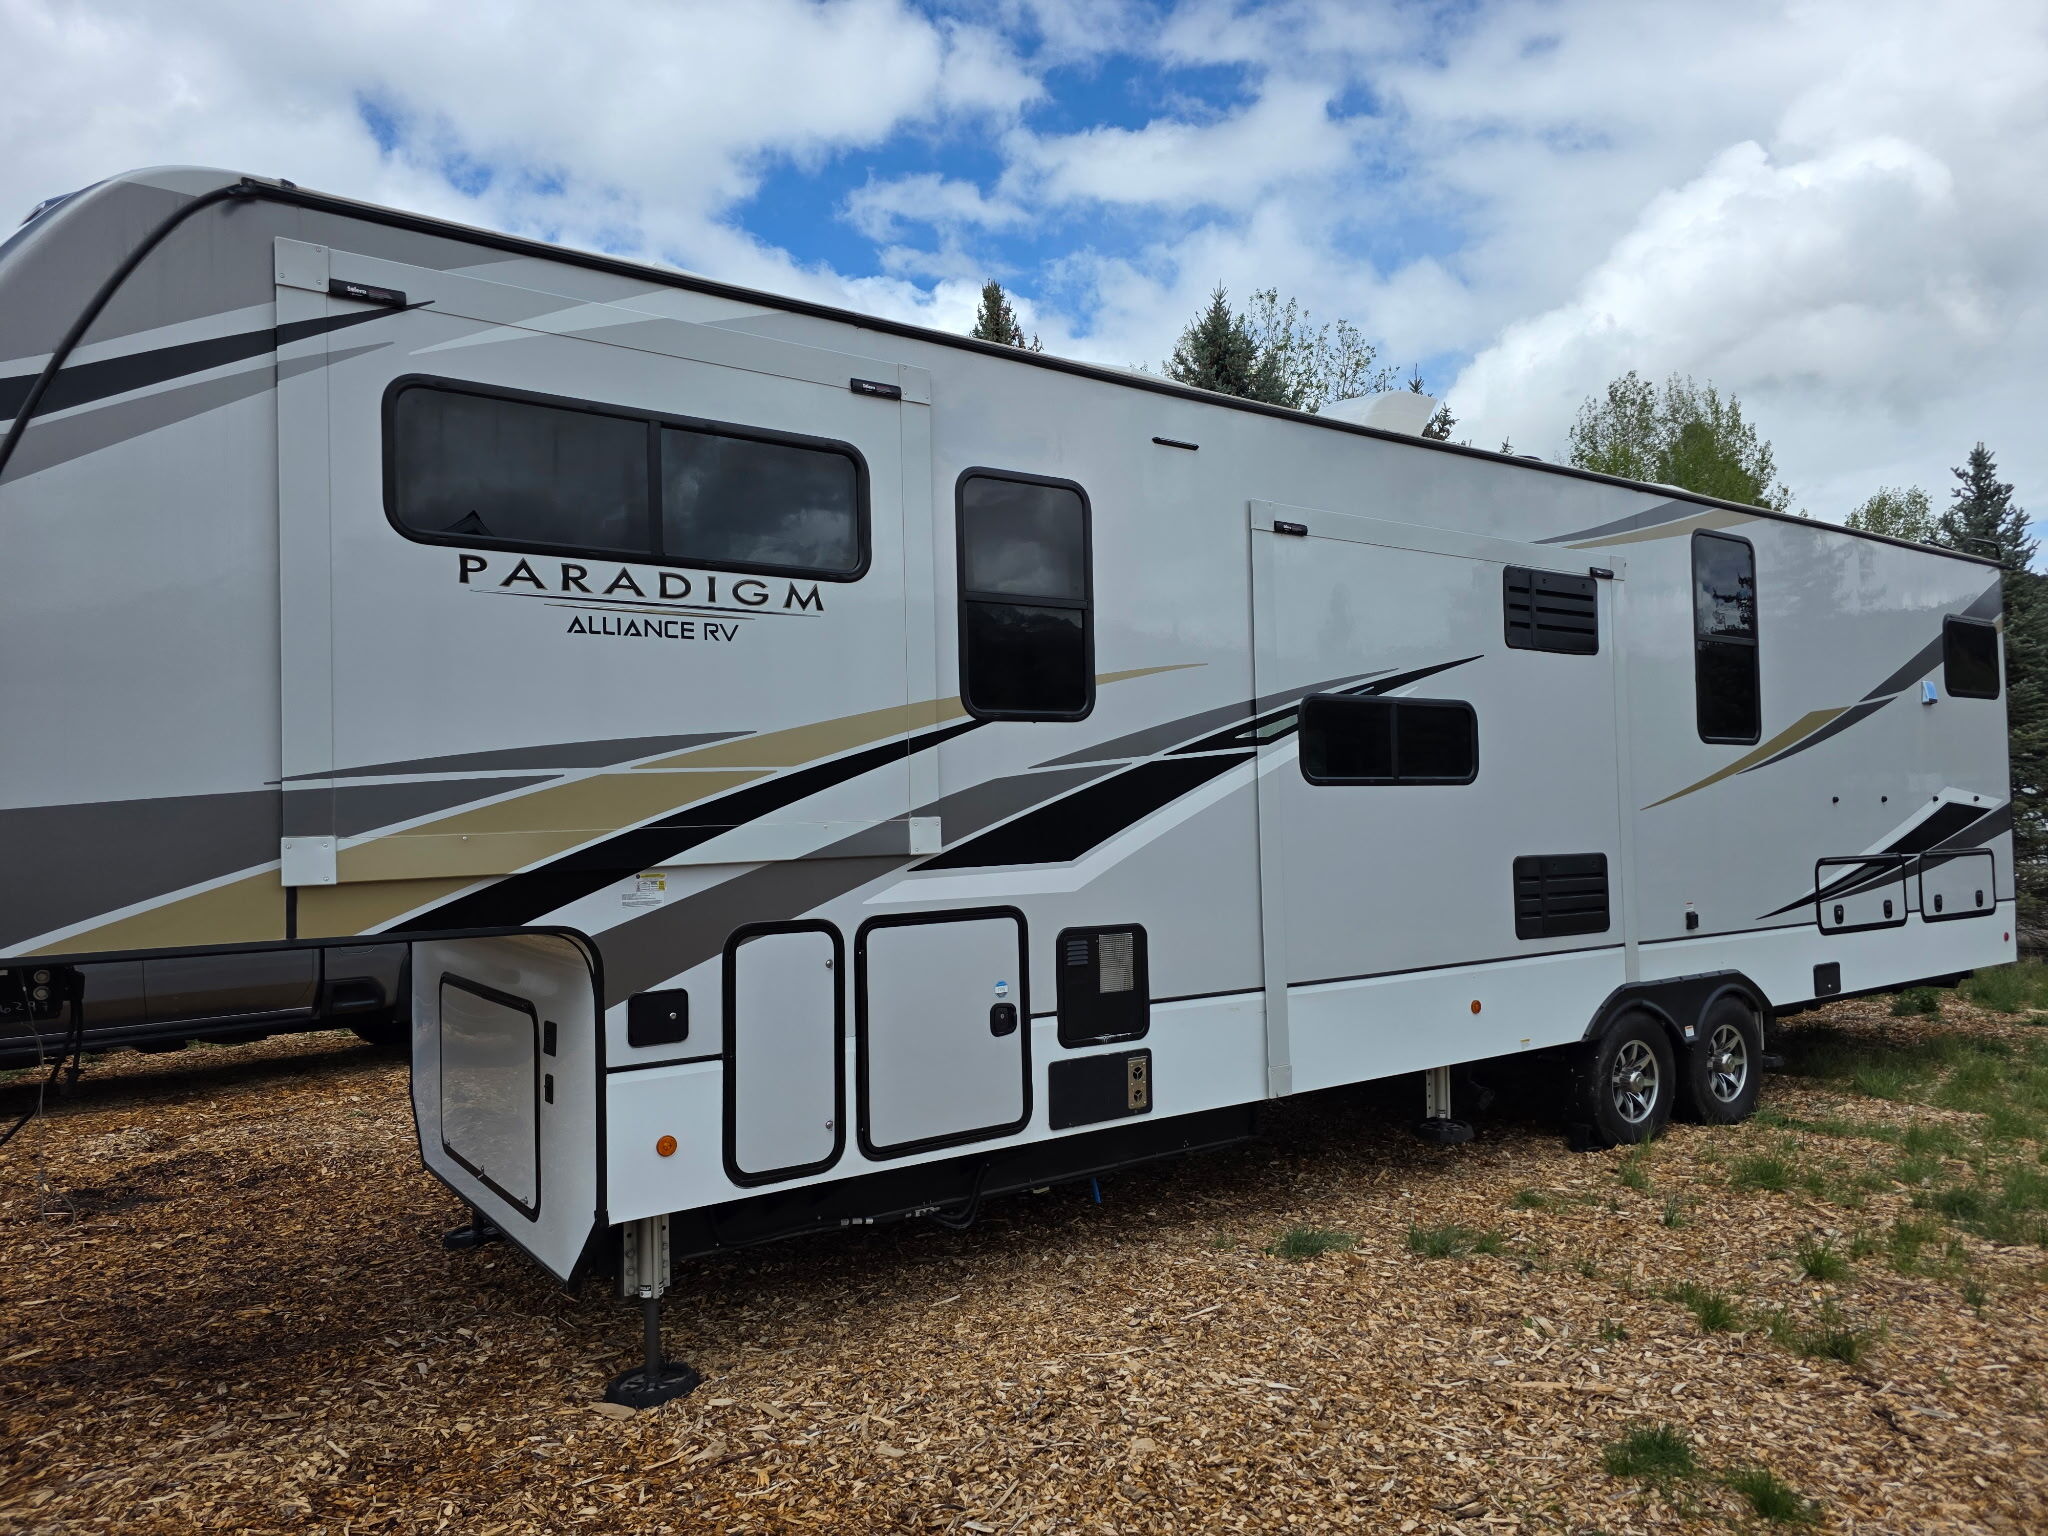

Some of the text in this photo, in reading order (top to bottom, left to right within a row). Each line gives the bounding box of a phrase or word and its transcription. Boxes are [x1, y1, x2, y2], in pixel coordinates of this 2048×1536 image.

[458, 553, 825, 612] PARADIGM
[566, 615, 739, 642] ALLIANCE RV
